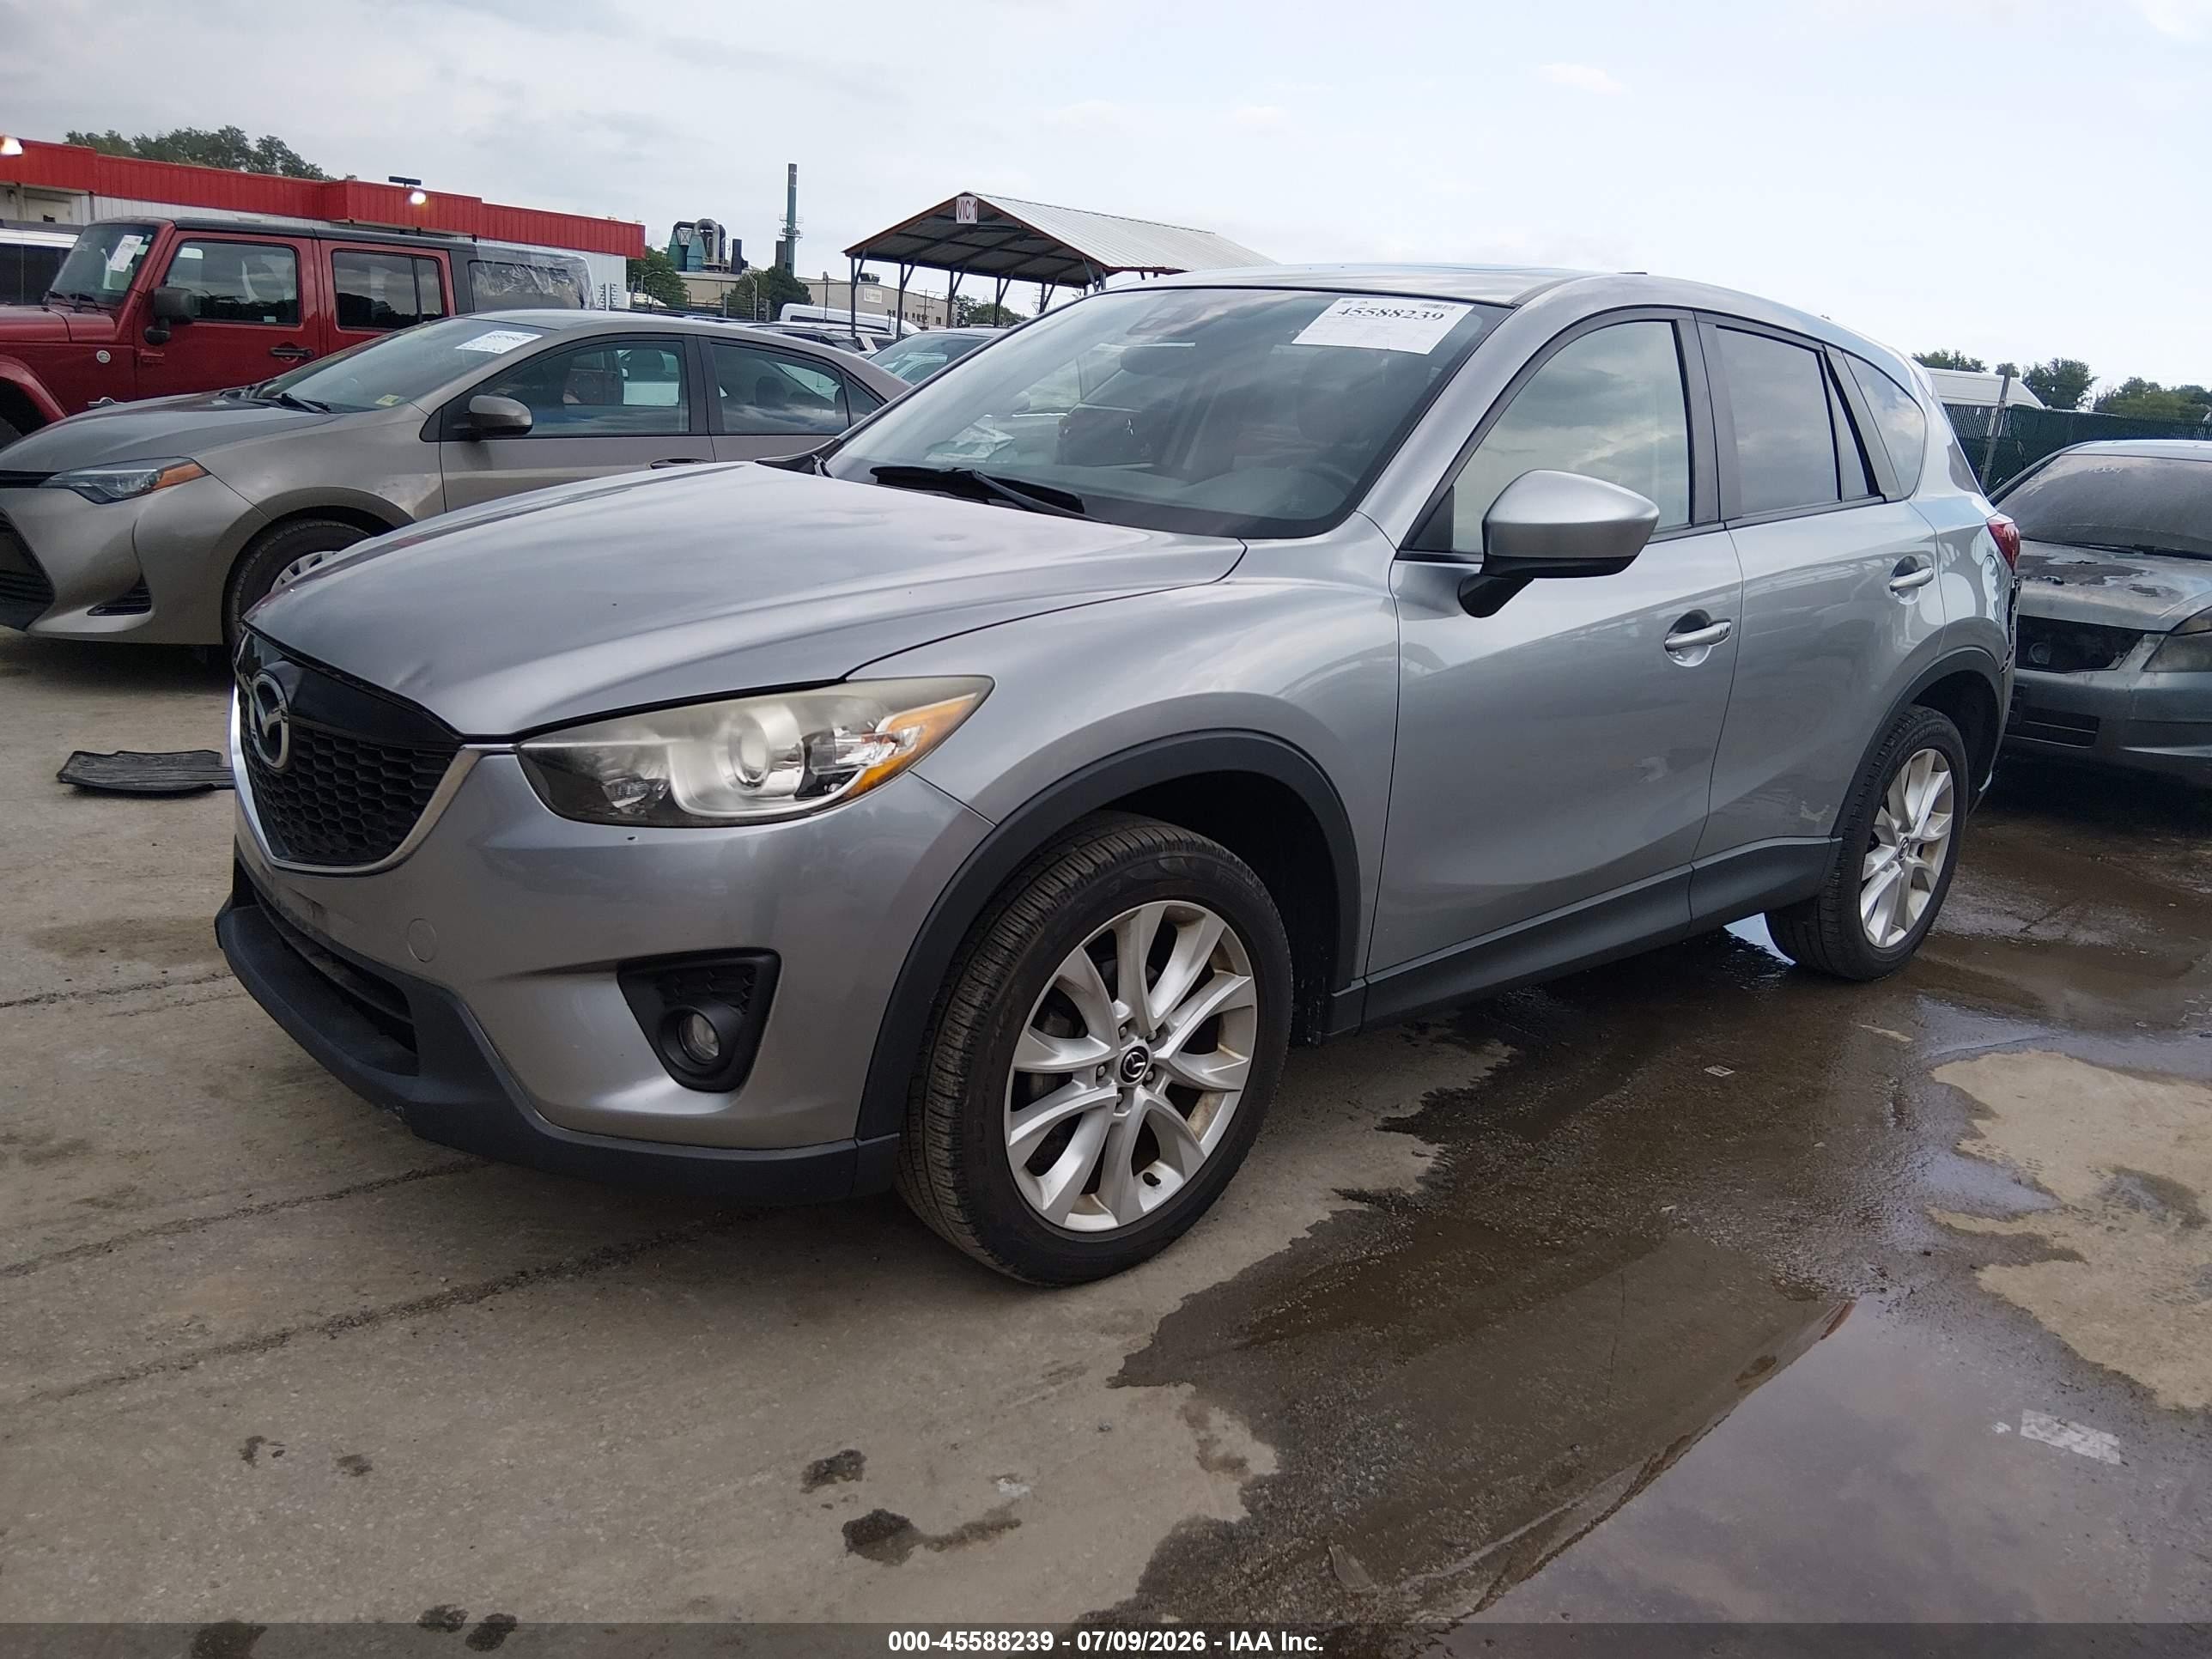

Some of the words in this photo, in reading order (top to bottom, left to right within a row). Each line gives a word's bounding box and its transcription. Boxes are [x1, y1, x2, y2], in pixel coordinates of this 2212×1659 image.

[957, 200, 971, 220] VIC
[972, 200, 977, 220] 1
[1337, 306, 1445, 322] 45588239
